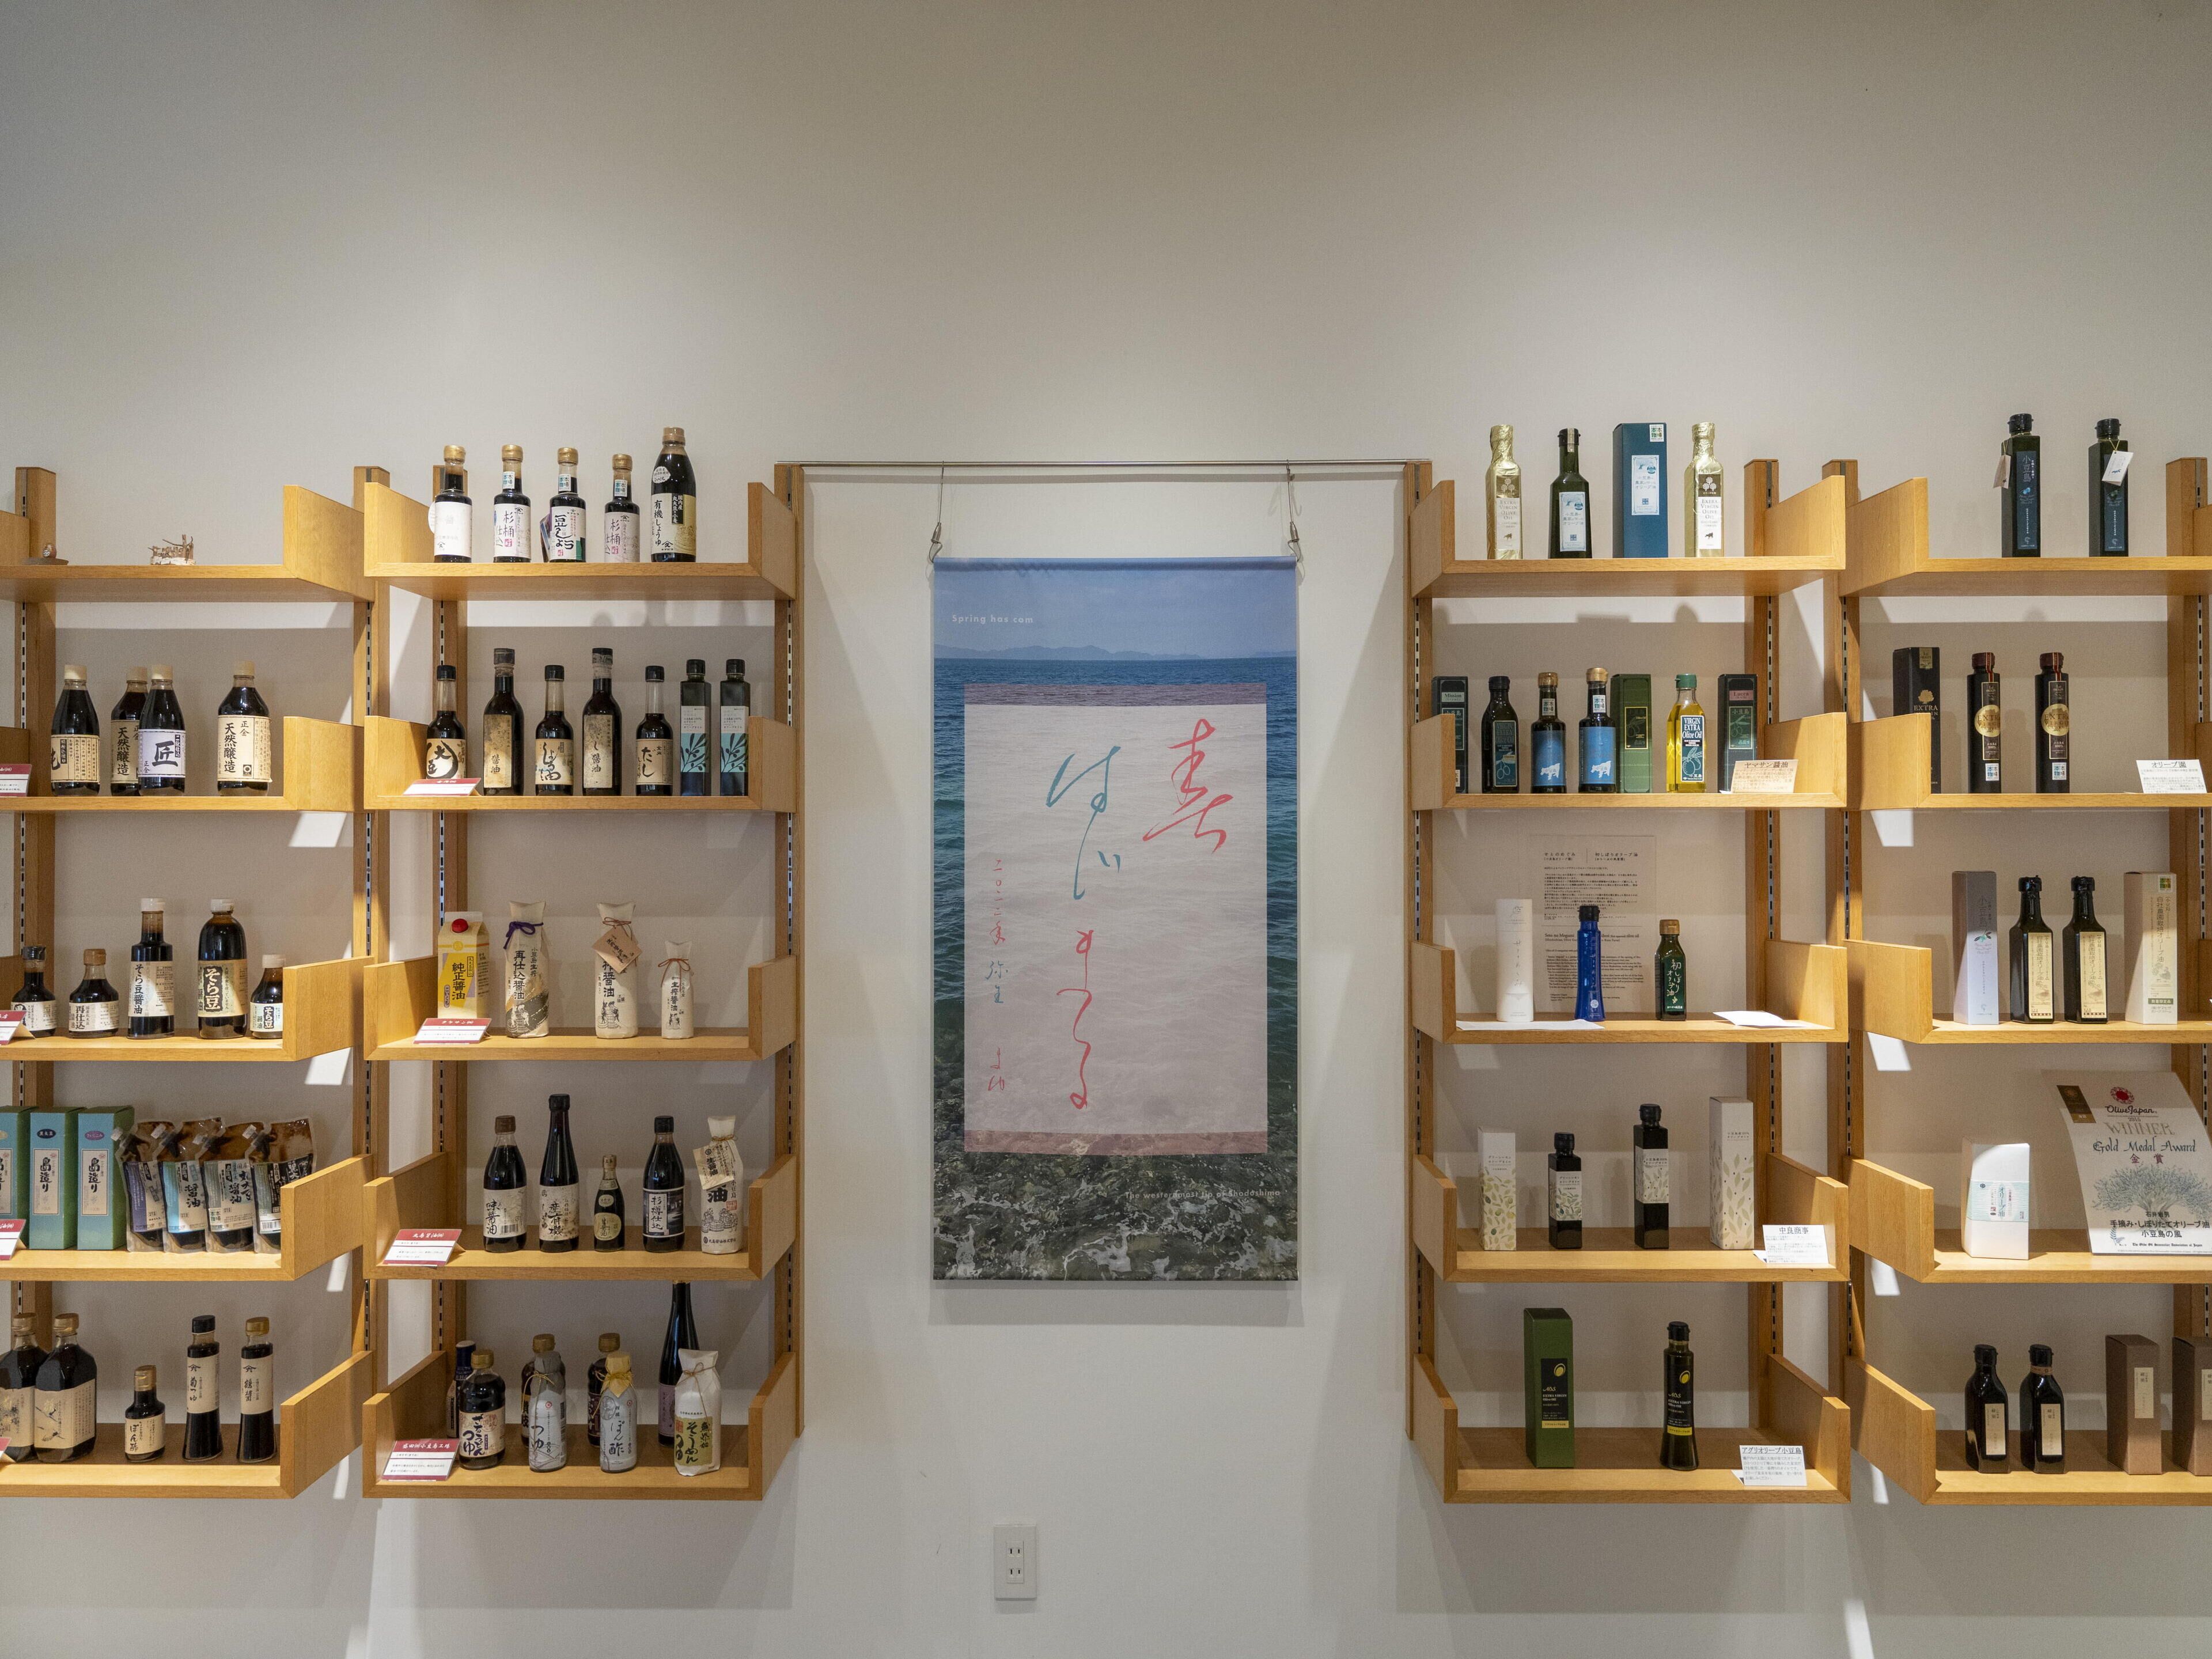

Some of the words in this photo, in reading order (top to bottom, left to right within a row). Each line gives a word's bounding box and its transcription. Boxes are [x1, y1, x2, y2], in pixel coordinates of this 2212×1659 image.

[654, 499, 663, 546] 有機しょうゆ
[952, 615, 986, 624] Spring
[240, 721, 249, 736] 正金
[152, 741, 178, 767] 匠
[641, 747, 657, 777] だし
[452, 963, 466, 1000] 純正醤油
[513, 950, 526, 999] 再仕込醤油
[134, 964, 144, 1014] そら豆醤油
[204, 968, 221, 1010] そら豆
[75, 1005, 85, 1029] 再仕込
[264, 1007, 274, 1029] そら豆
[2104, 1123, 2175, 1135] WINNER
[2093, 1137, 2119, 1153] Gold
[2124, 1137, 2156, 1152] Medal
[2160, 1140, 2196, 1152] Award
[2130, 1153, 2140, 1164] 金
[2154, 1154, 2164, 1164] 賞
[651, 1196, 664, 1230] 杉樽仕込
[2110, 1220, 2210, 1229] 手摘み・しぼりたてオリーブ油
[463, 1430, 475, 1456] つゆ
[685, 1422, 699, 1464] そうめん
